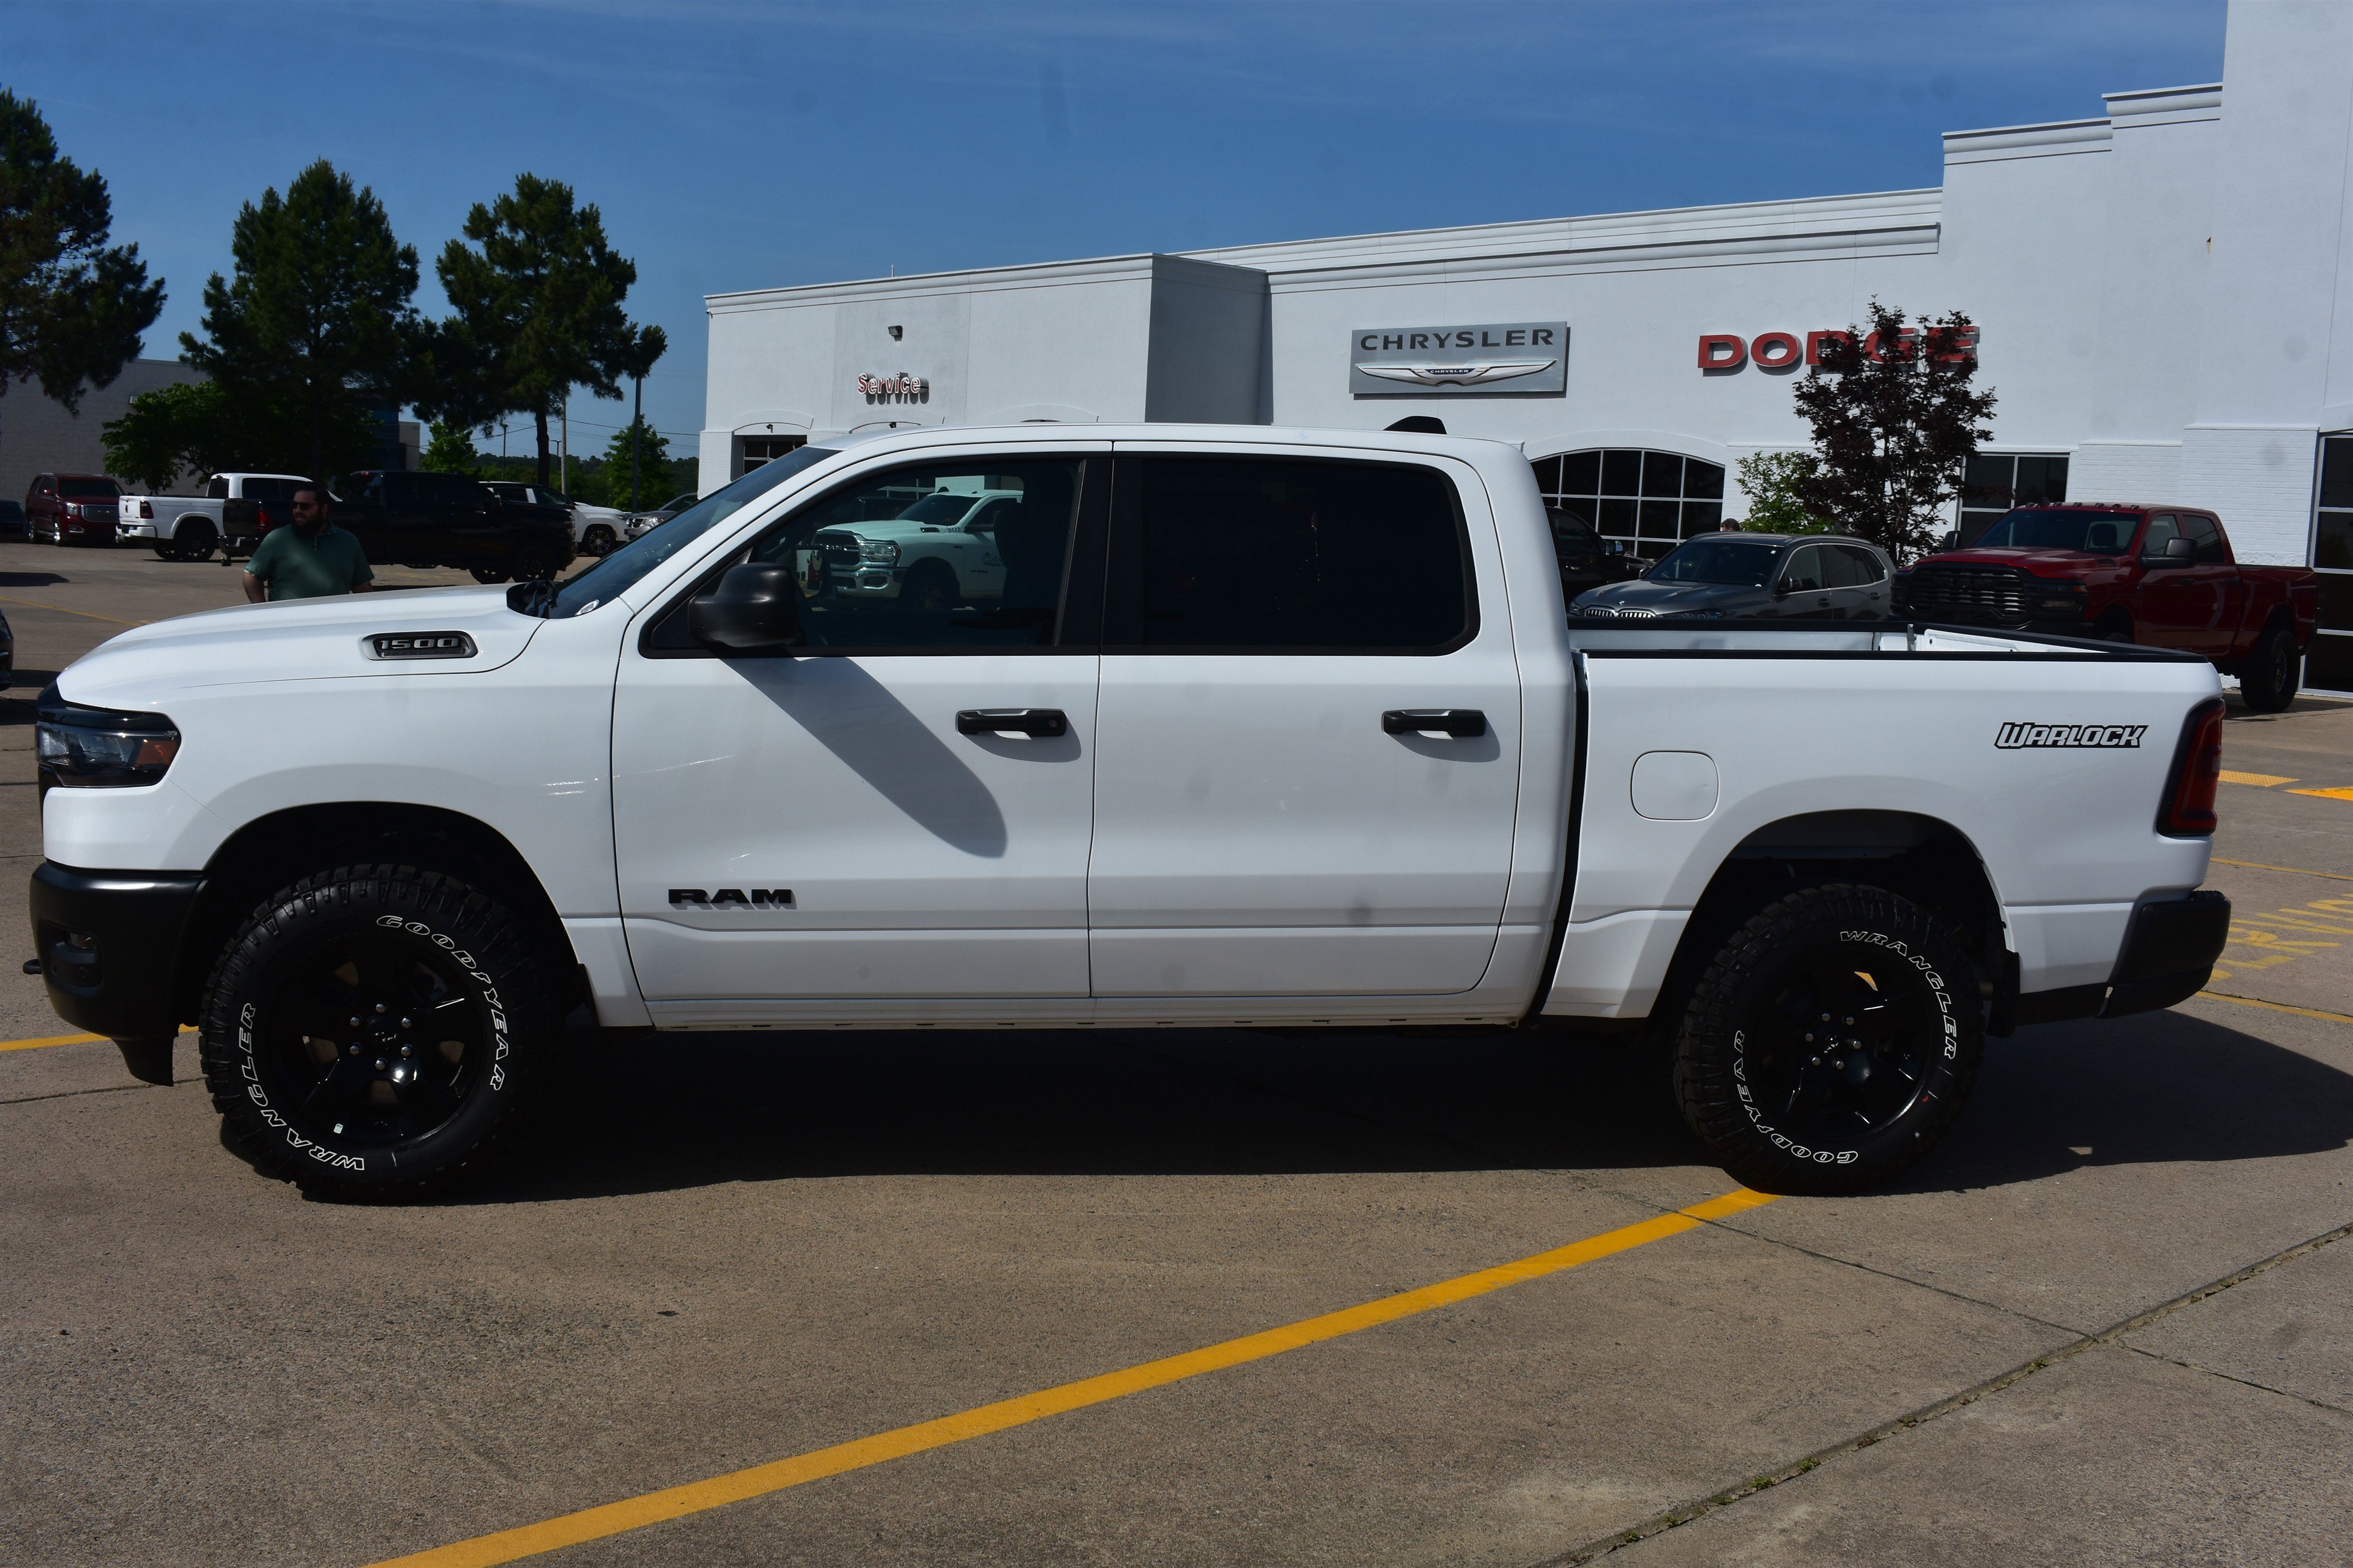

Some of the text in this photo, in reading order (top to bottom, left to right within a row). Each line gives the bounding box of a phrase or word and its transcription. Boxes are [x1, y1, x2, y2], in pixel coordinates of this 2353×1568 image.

[1360, 328, 1553, 351] CHRYSLER
[857, 371, 921, 394] Service
[380, 638, 458, 650] 1500
[1994, 722, 2148, 749] WARLOCK
[668, 889, 792, 903] RAM
[376, 915, 509, 1091] GOODYEAR
[1840, 930, 1958, 1060] WRANGLER
[238, 1002, 365, 1172] WRANGLER
[1733, 1030, 1859, 1164] GOODYEAR
